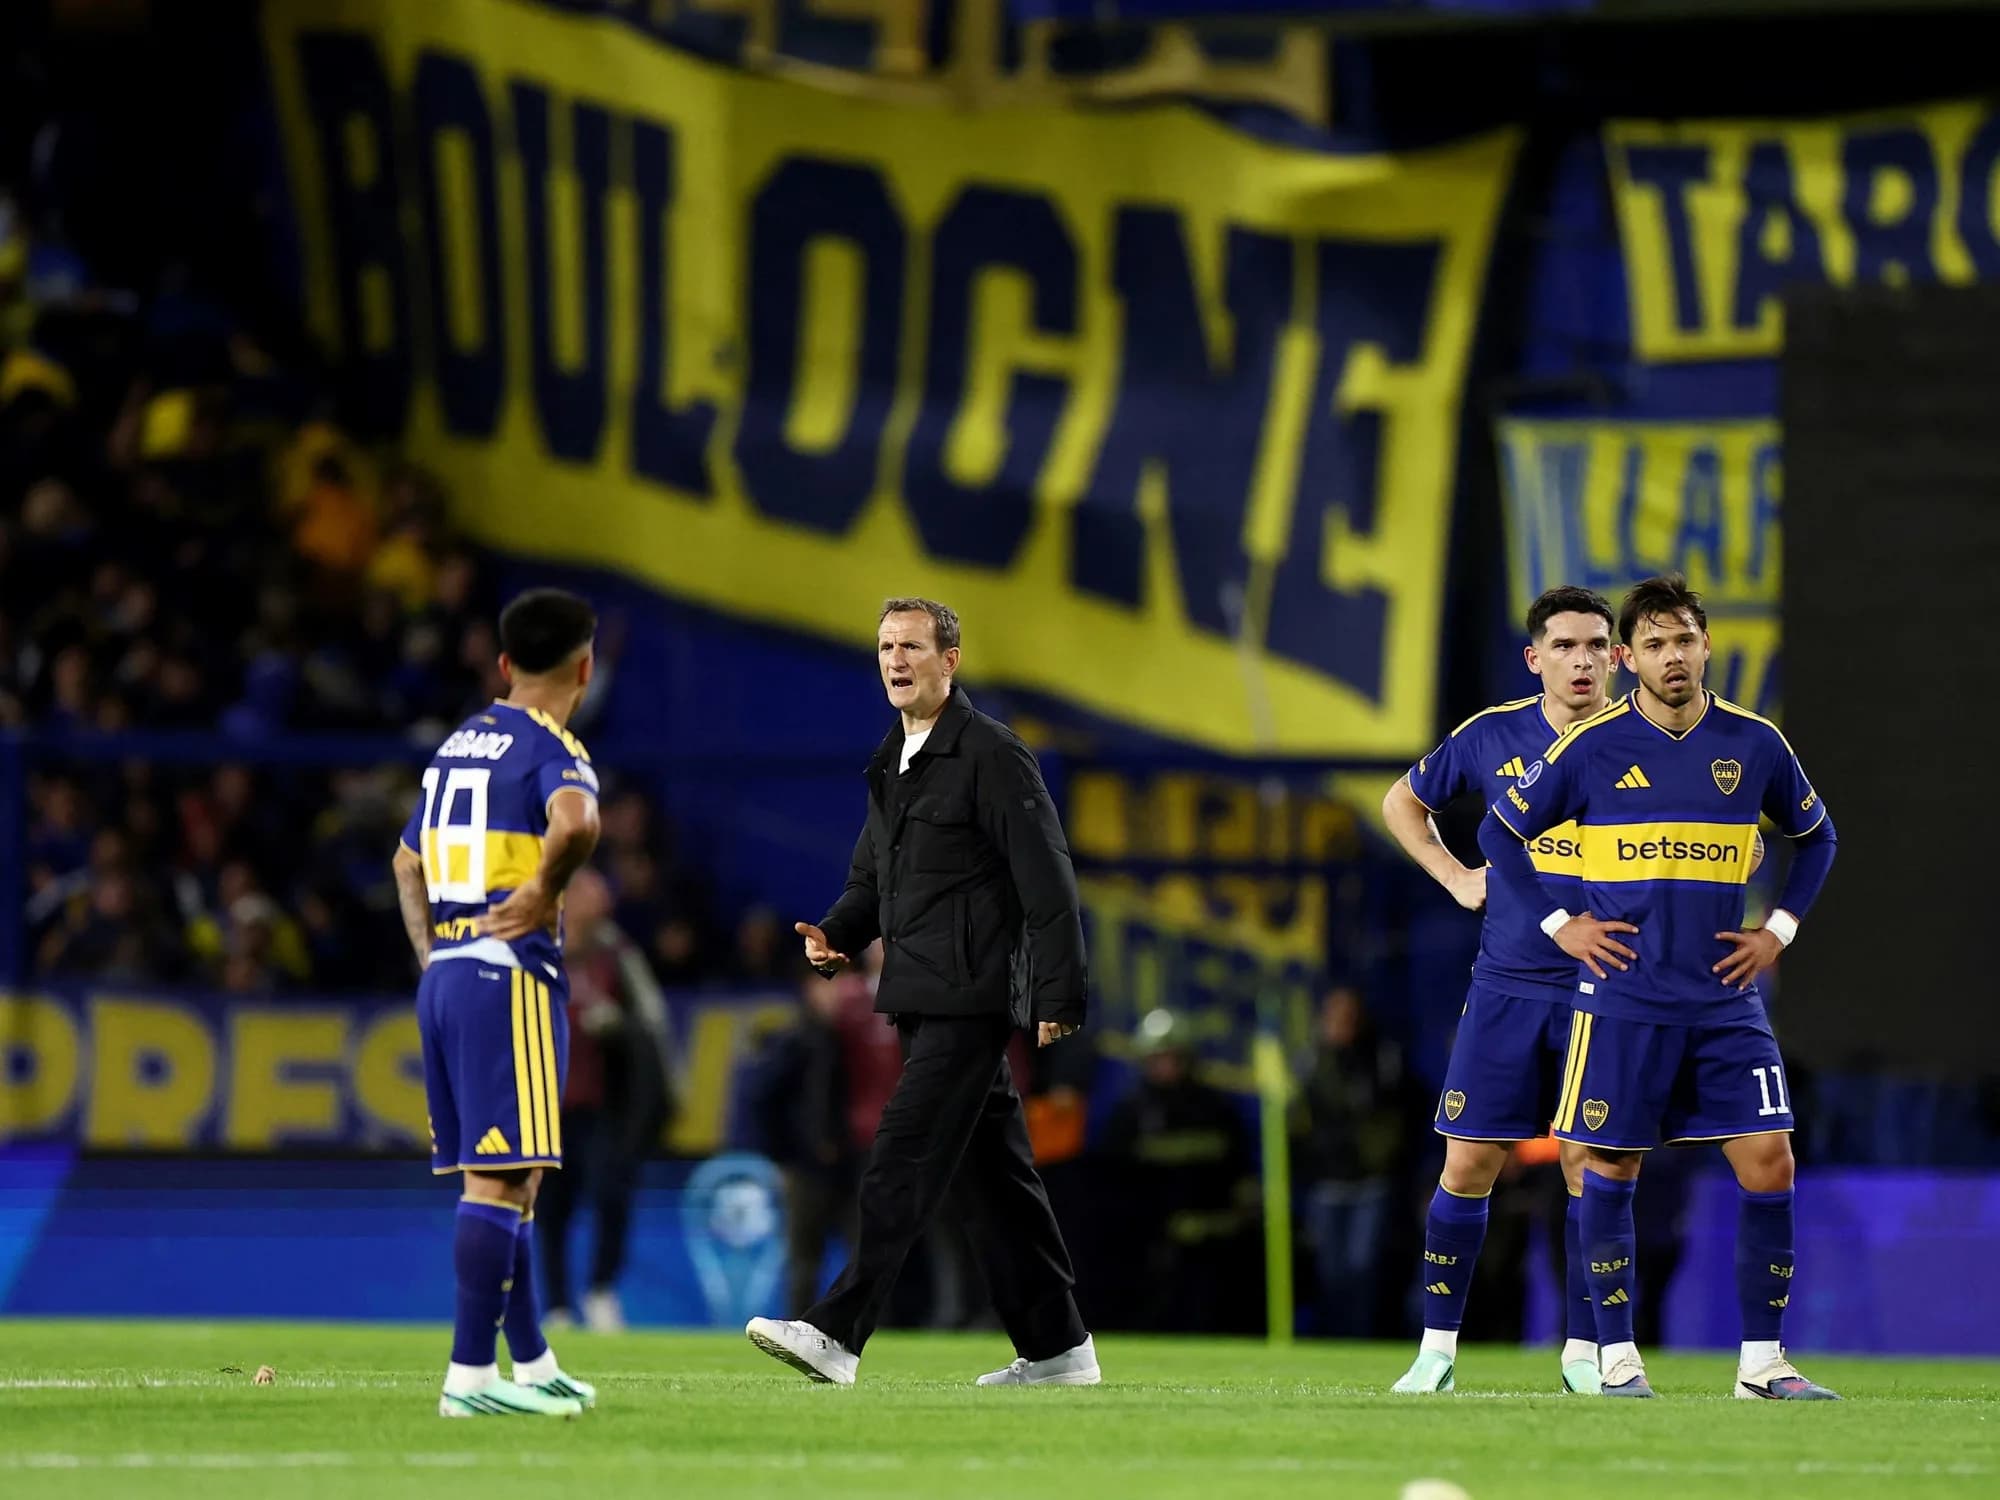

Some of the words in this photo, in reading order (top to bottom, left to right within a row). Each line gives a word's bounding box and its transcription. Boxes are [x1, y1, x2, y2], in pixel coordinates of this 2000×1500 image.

[302, 30, 1446, 707] BOULOGNE
[421, 767, 491, 904] 18
[1617, 836, 1738, 862] betsson
[1752, 1065, 1790, 1116] 11
[1424, 1250, 1457, 1265] CABJ
[1591, 1257, 1629, 1273] CABJ
